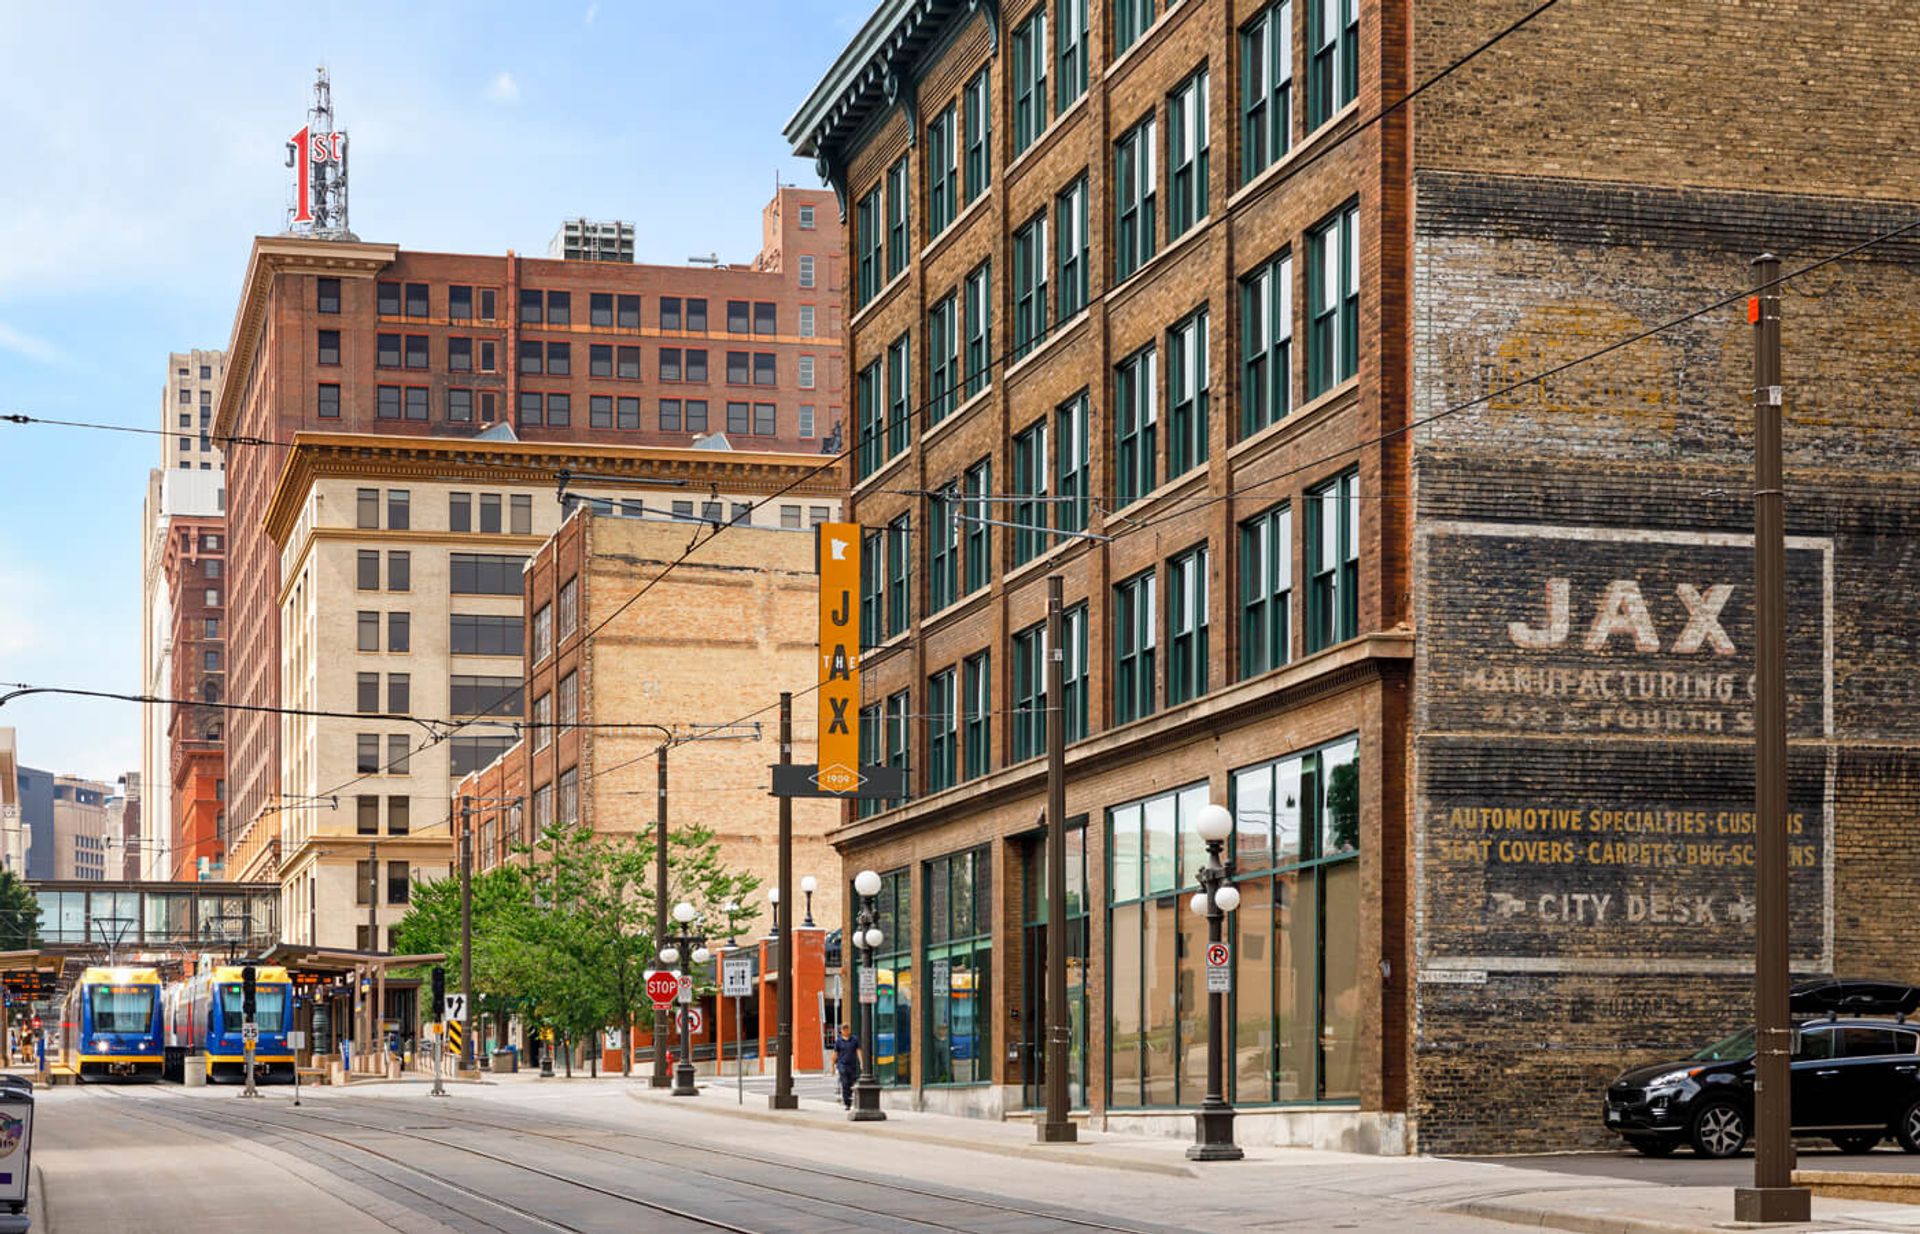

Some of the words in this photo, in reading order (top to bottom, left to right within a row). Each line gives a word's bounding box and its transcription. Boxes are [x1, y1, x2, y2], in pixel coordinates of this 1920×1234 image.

[1508, 577, 1736, 655] JAX
[823, 655, 856, 669] THE
[828, 590, 850, 734] JAX
[1450, 808, 1582, 831] AUTOMOTIVE
[1589, 810, 1707, 833] SPECIALTIES
[1499, 840, 1576, 863] COVERS
[1538, 894, 1612, 922] CITY
[1627, 895, 1716, 924] DESK
[648, 981, 676, 994] STOP
[244, 1028, 258, 1038] 25
